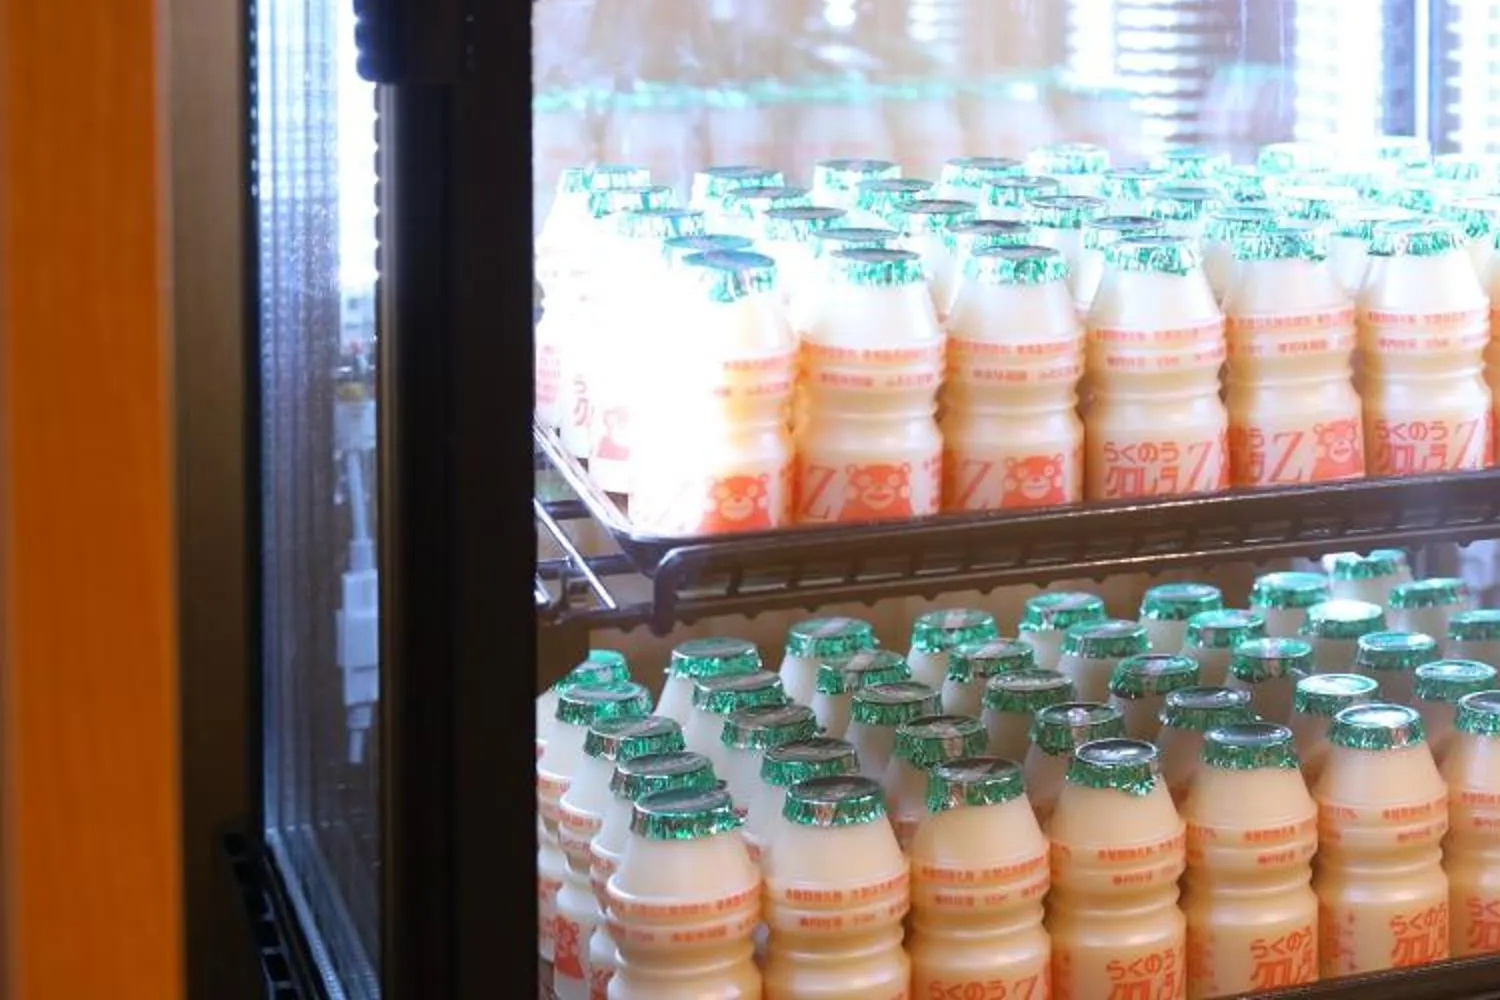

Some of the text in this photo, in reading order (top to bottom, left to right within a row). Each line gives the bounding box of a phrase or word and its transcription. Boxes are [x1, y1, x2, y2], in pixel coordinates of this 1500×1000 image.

[1375, 419, 1449, 441] らくのう
[1104, 440, 1180, 463] らくのう
[1268, 430, 1305, 483] Z
